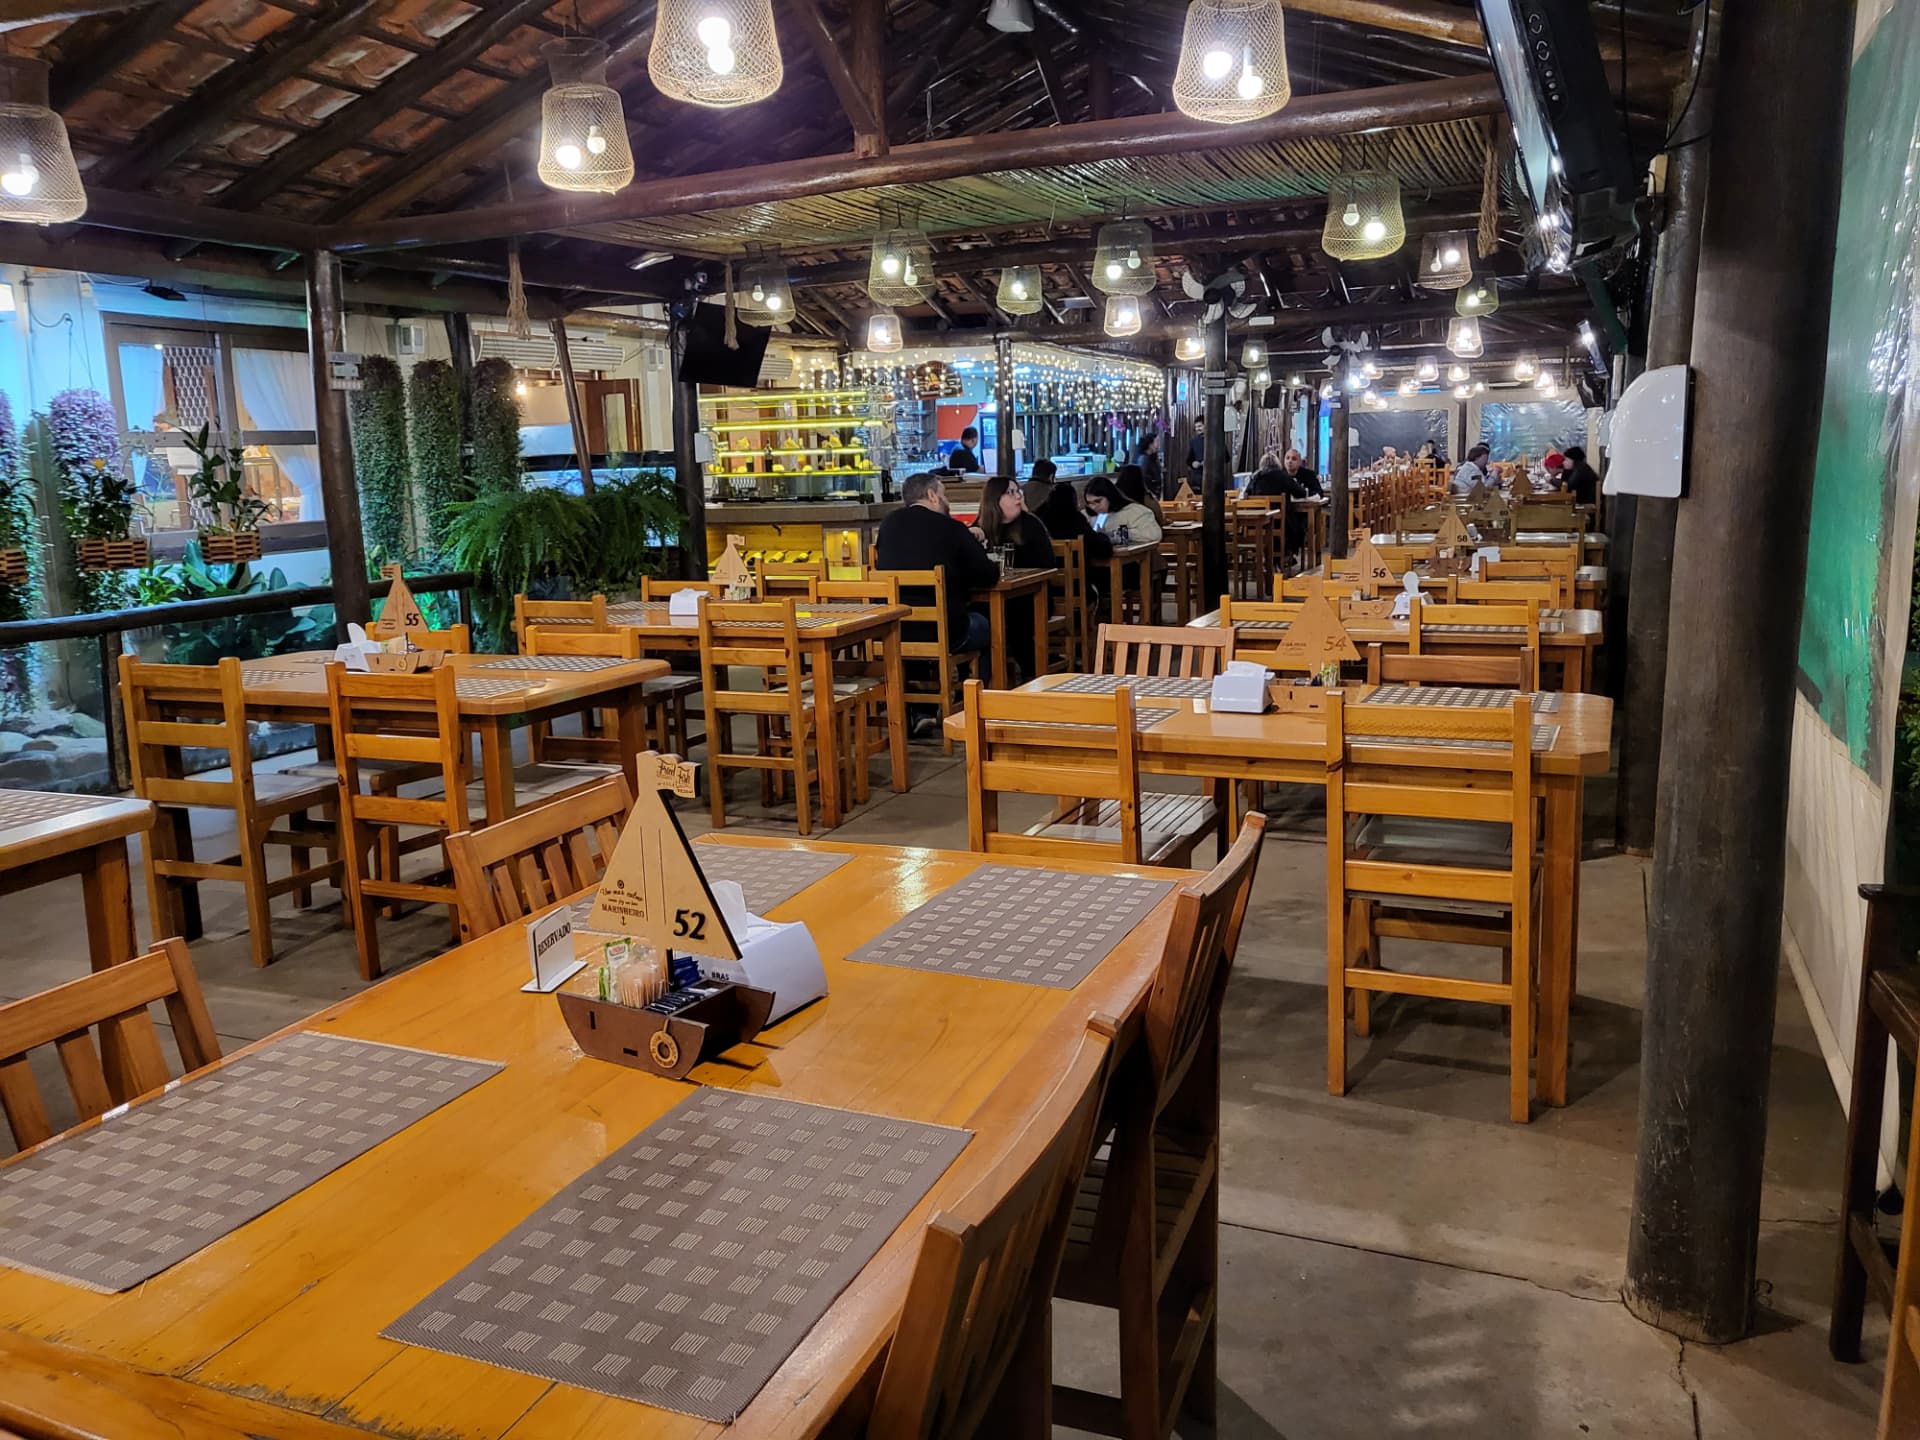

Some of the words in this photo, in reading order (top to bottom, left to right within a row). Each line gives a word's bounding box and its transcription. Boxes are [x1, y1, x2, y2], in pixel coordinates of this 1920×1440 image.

[1456, 534, 1468, 543] 58
[737, 575, 748, 583] 57
[1371, 567, 1387, 578] 56
[405, 613, 419, 626] 55
[1323, 635, 1347, 652] 54
[601, 903, 645, 918] MARINHEIRO
[673, 908, 706, 940] 52
[537, 922, 571, 957] RESERVADO
